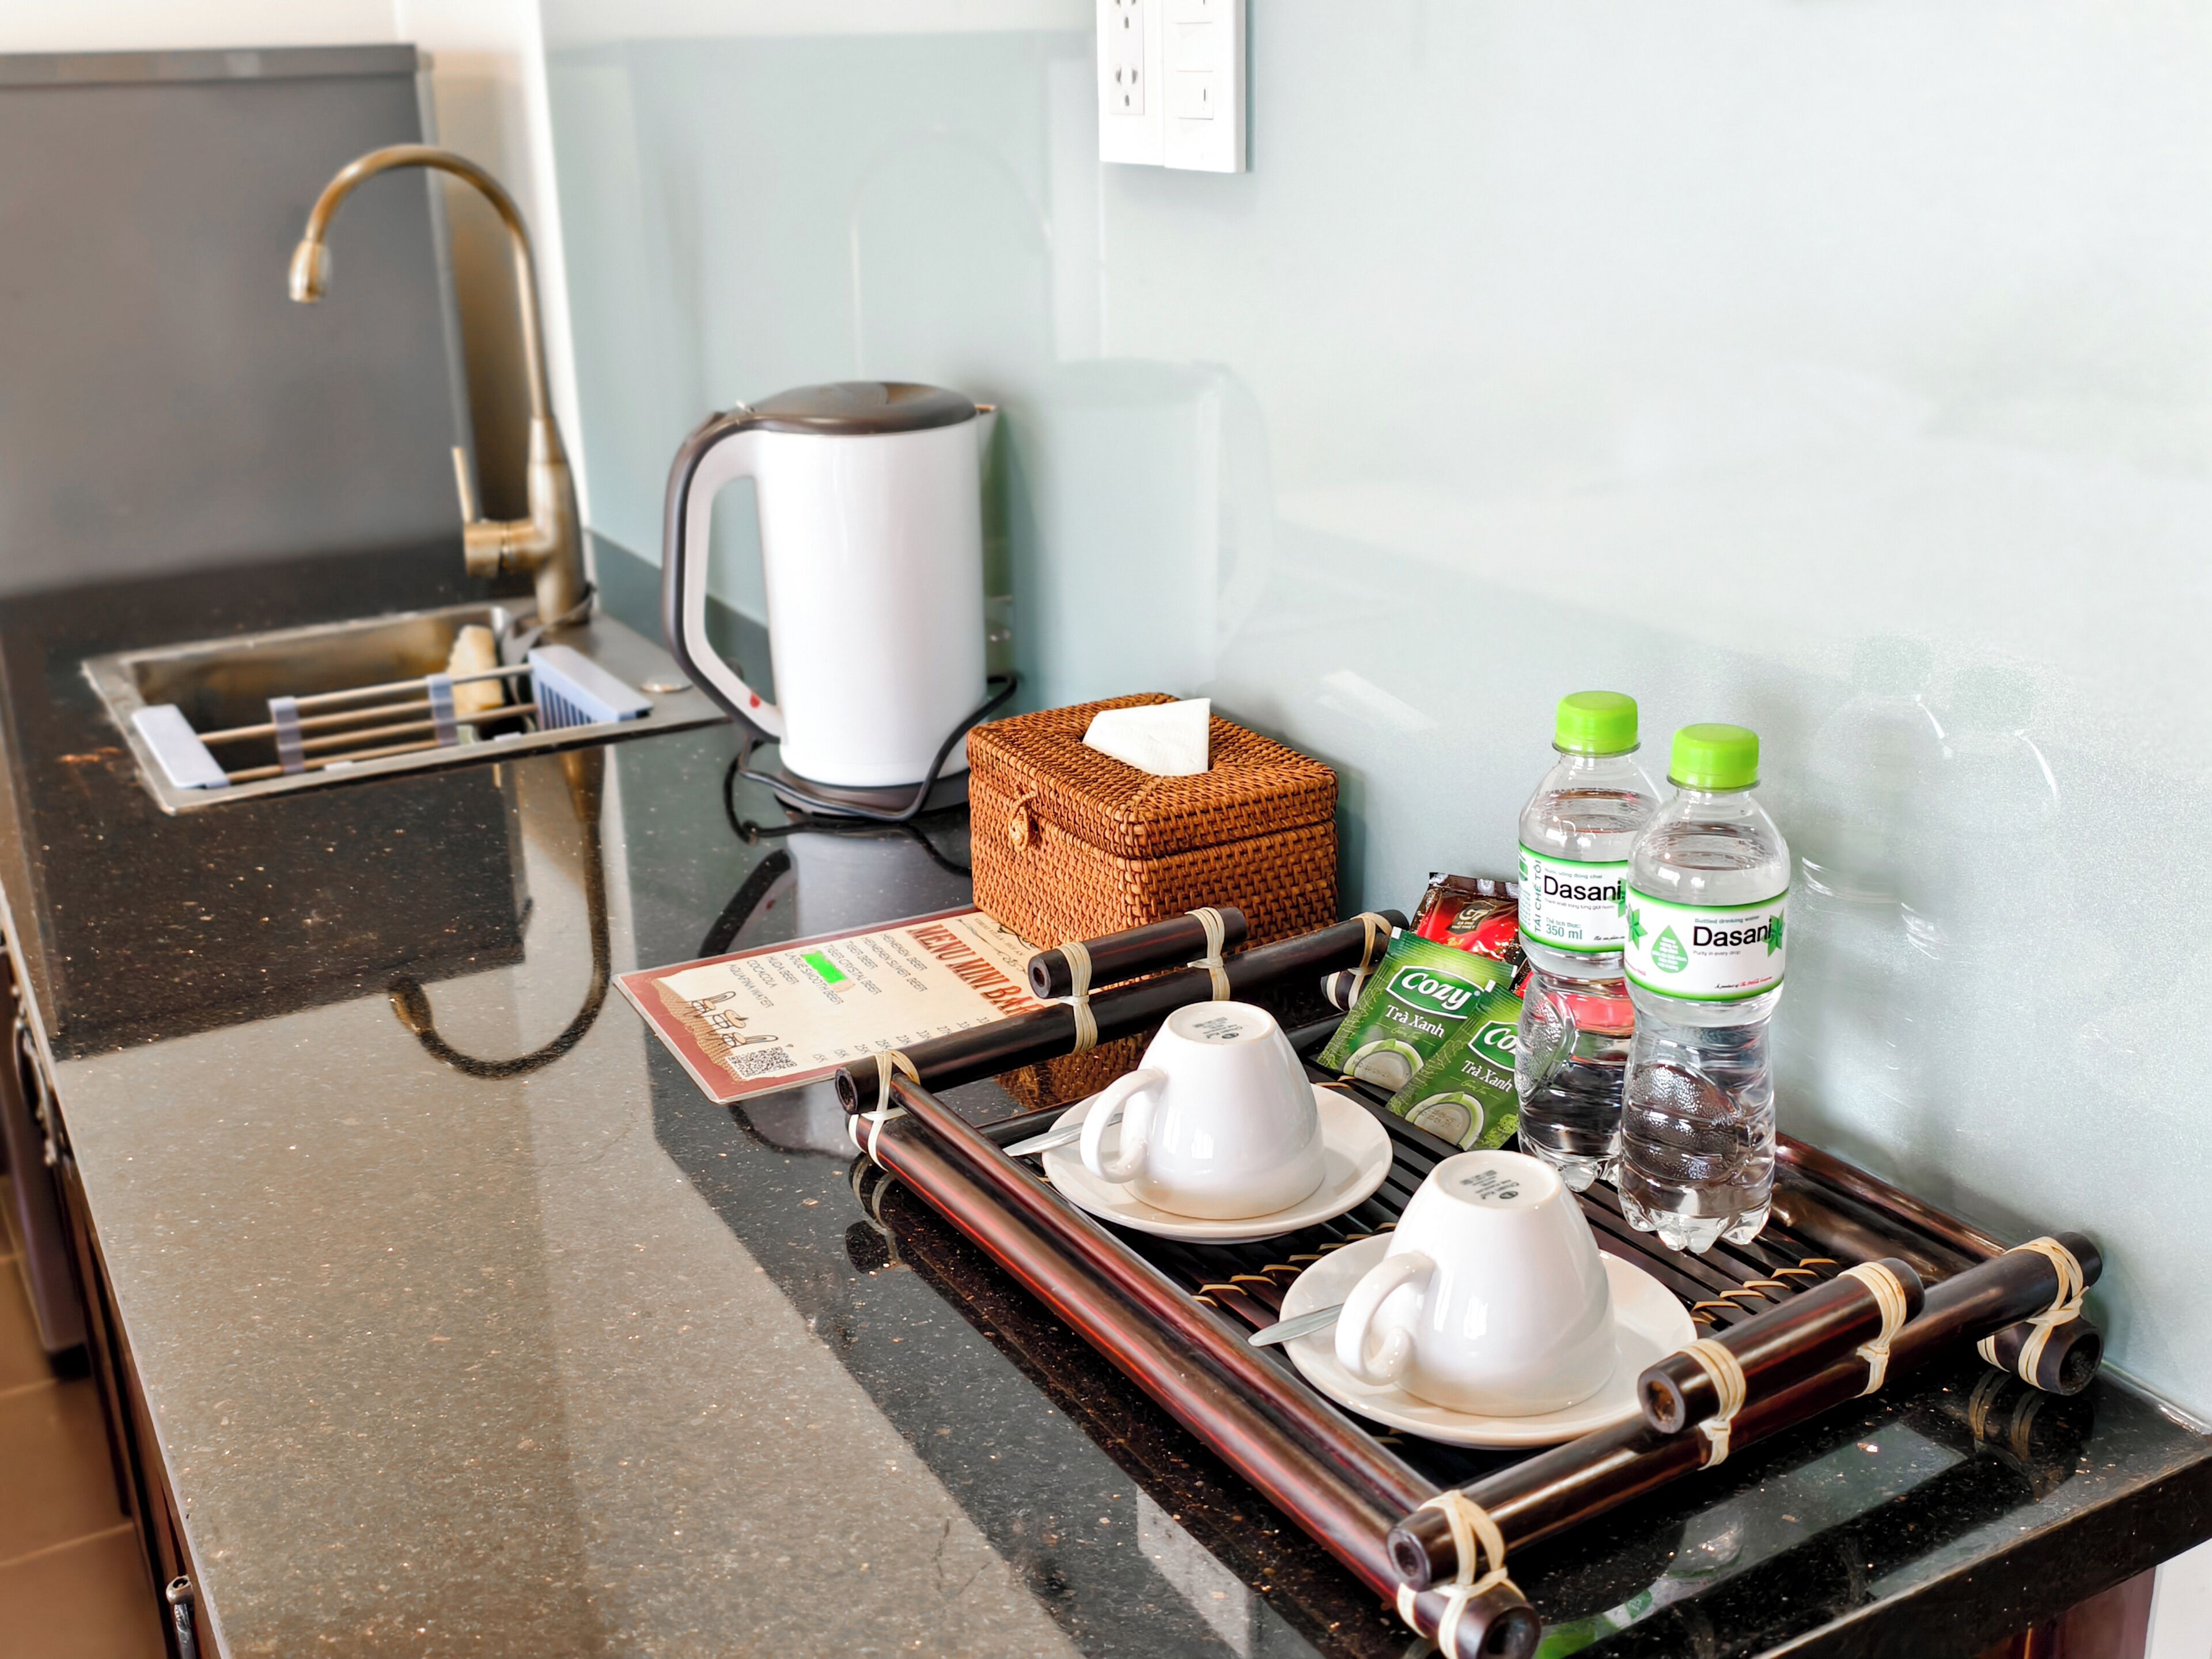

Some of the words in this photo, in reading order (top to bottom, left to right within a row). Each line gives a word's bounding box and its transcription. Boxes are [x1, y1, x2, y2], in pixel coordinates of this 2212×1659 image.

[1533, 859, 1541, 880] TÔI
[1544, 874, 1622, 900] Dasani
[1459, 908, 1489, 921] G7
[1546, 923, 1565, 937] 350
[1569, 929, 1582, 940] ml
[1693, 918, 1772, 946] Dasani
[843, 941, 863, 955] TIGER
[857, 955, 878, 969] BEER
[861, 937, 892, 960] HEINEKEN
[906, 978, 927, 991] BEER
[880, 934, 912, 956] HEINEKEN
[906, 957, 927, 971] BEER
[747, 960, 778, 987] COCACOLA
[767, 956, 785, 971] HUDA
[779, 970, 799, 984] BEER
[785, 952, 805, 968] LARUE
[800, 968, 830, 991] SMOOTH
[823, 990, 844, 1005] BEER
[823, 945, 844, 959] TIGER
[861, 980, 882, 994] BEER
[906, 924, 976, 960] MENU
[946, 957, 1010, 990] MINI
[980, 986, 1046, 1018] BAR
[751, 988, 774, 1008] WATER
[1402, 972, 1472, 1010] Cozy
[1385, 1004, 1409, 1024] Trà
[1409, 1014, 1445, 1038] Xanh
[1461, 1060, 1482, 1077] Trà
[1479, 1069, 1513, 1092] Xanh
